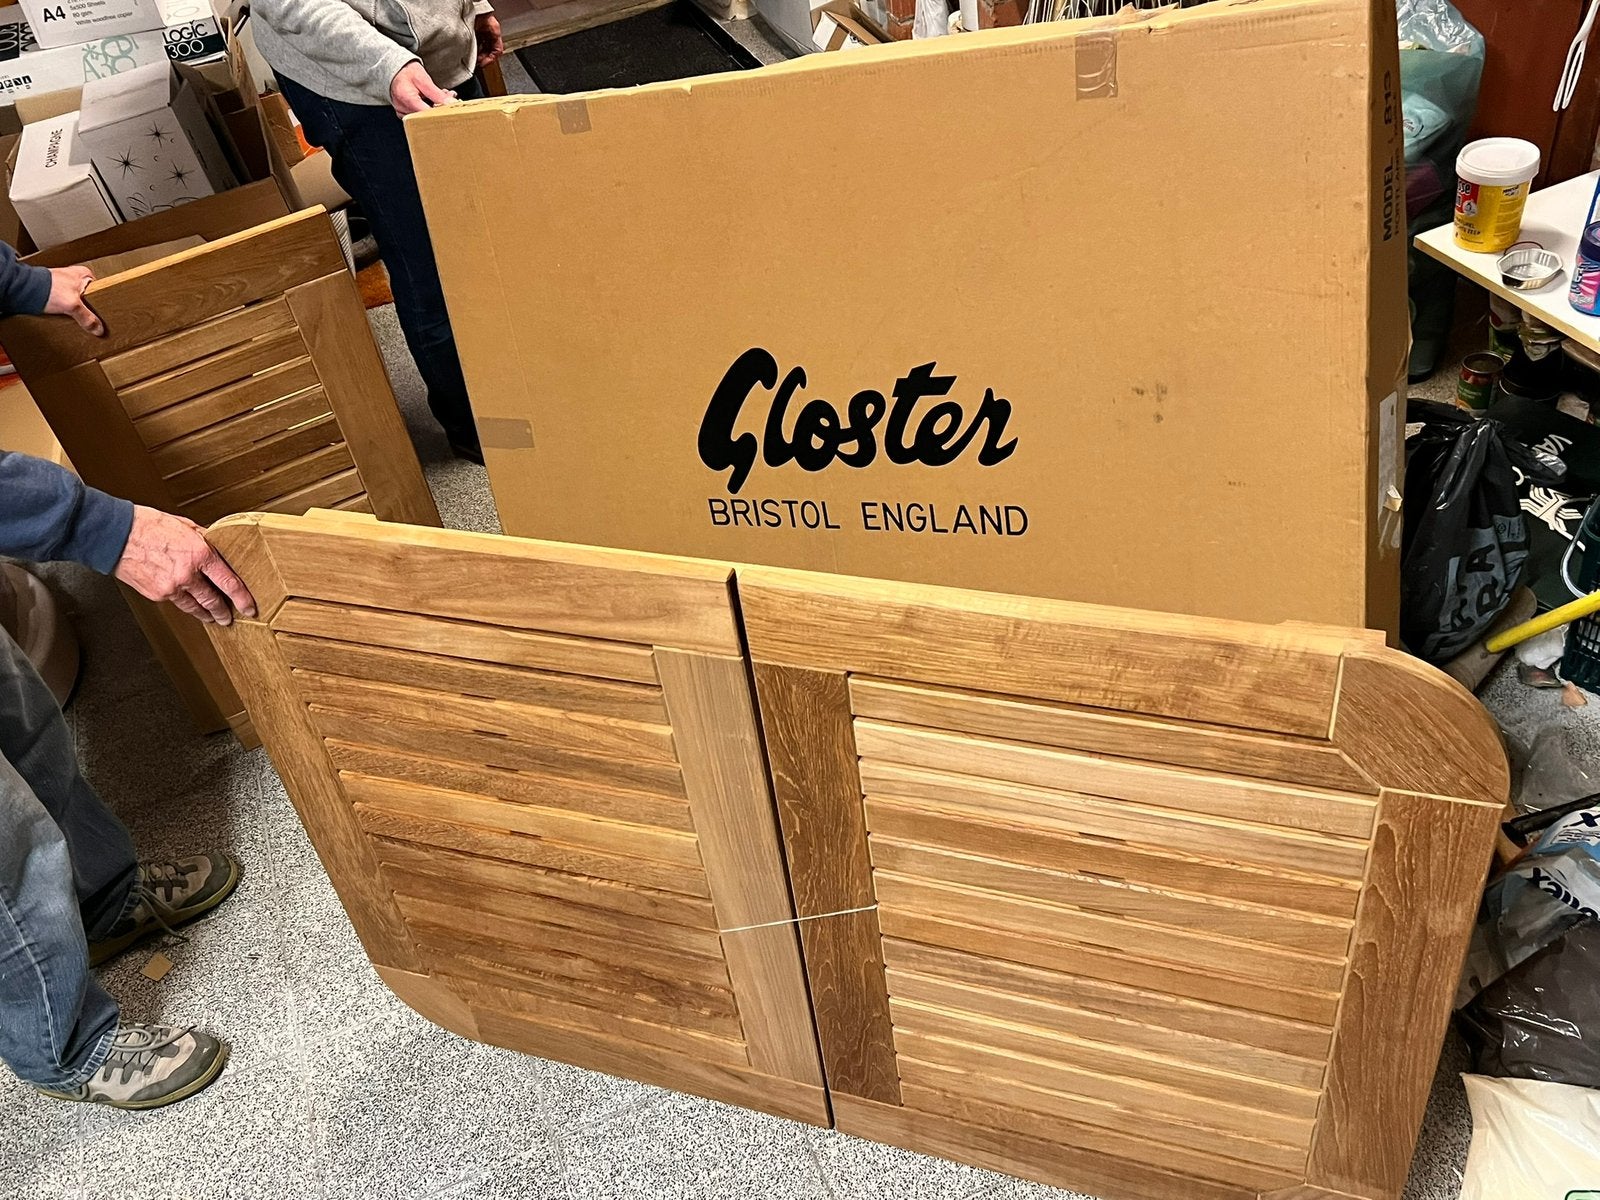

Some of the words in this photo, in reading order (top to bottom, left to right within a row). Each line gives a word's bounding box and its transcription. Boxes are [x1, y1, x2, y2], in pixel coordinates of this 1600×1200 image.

[43, 5, 66, 23] A4
[162, 20, 208, 44] LOGIC
[168, 39, 204, 59] 300
[1383, 155, 1393, 242] MODEL
[698, 347, 1018, 494] Gloster
[708, 498, 841, 530] BRISTOL
[862, 502, 1029, 535] ENGLAND
